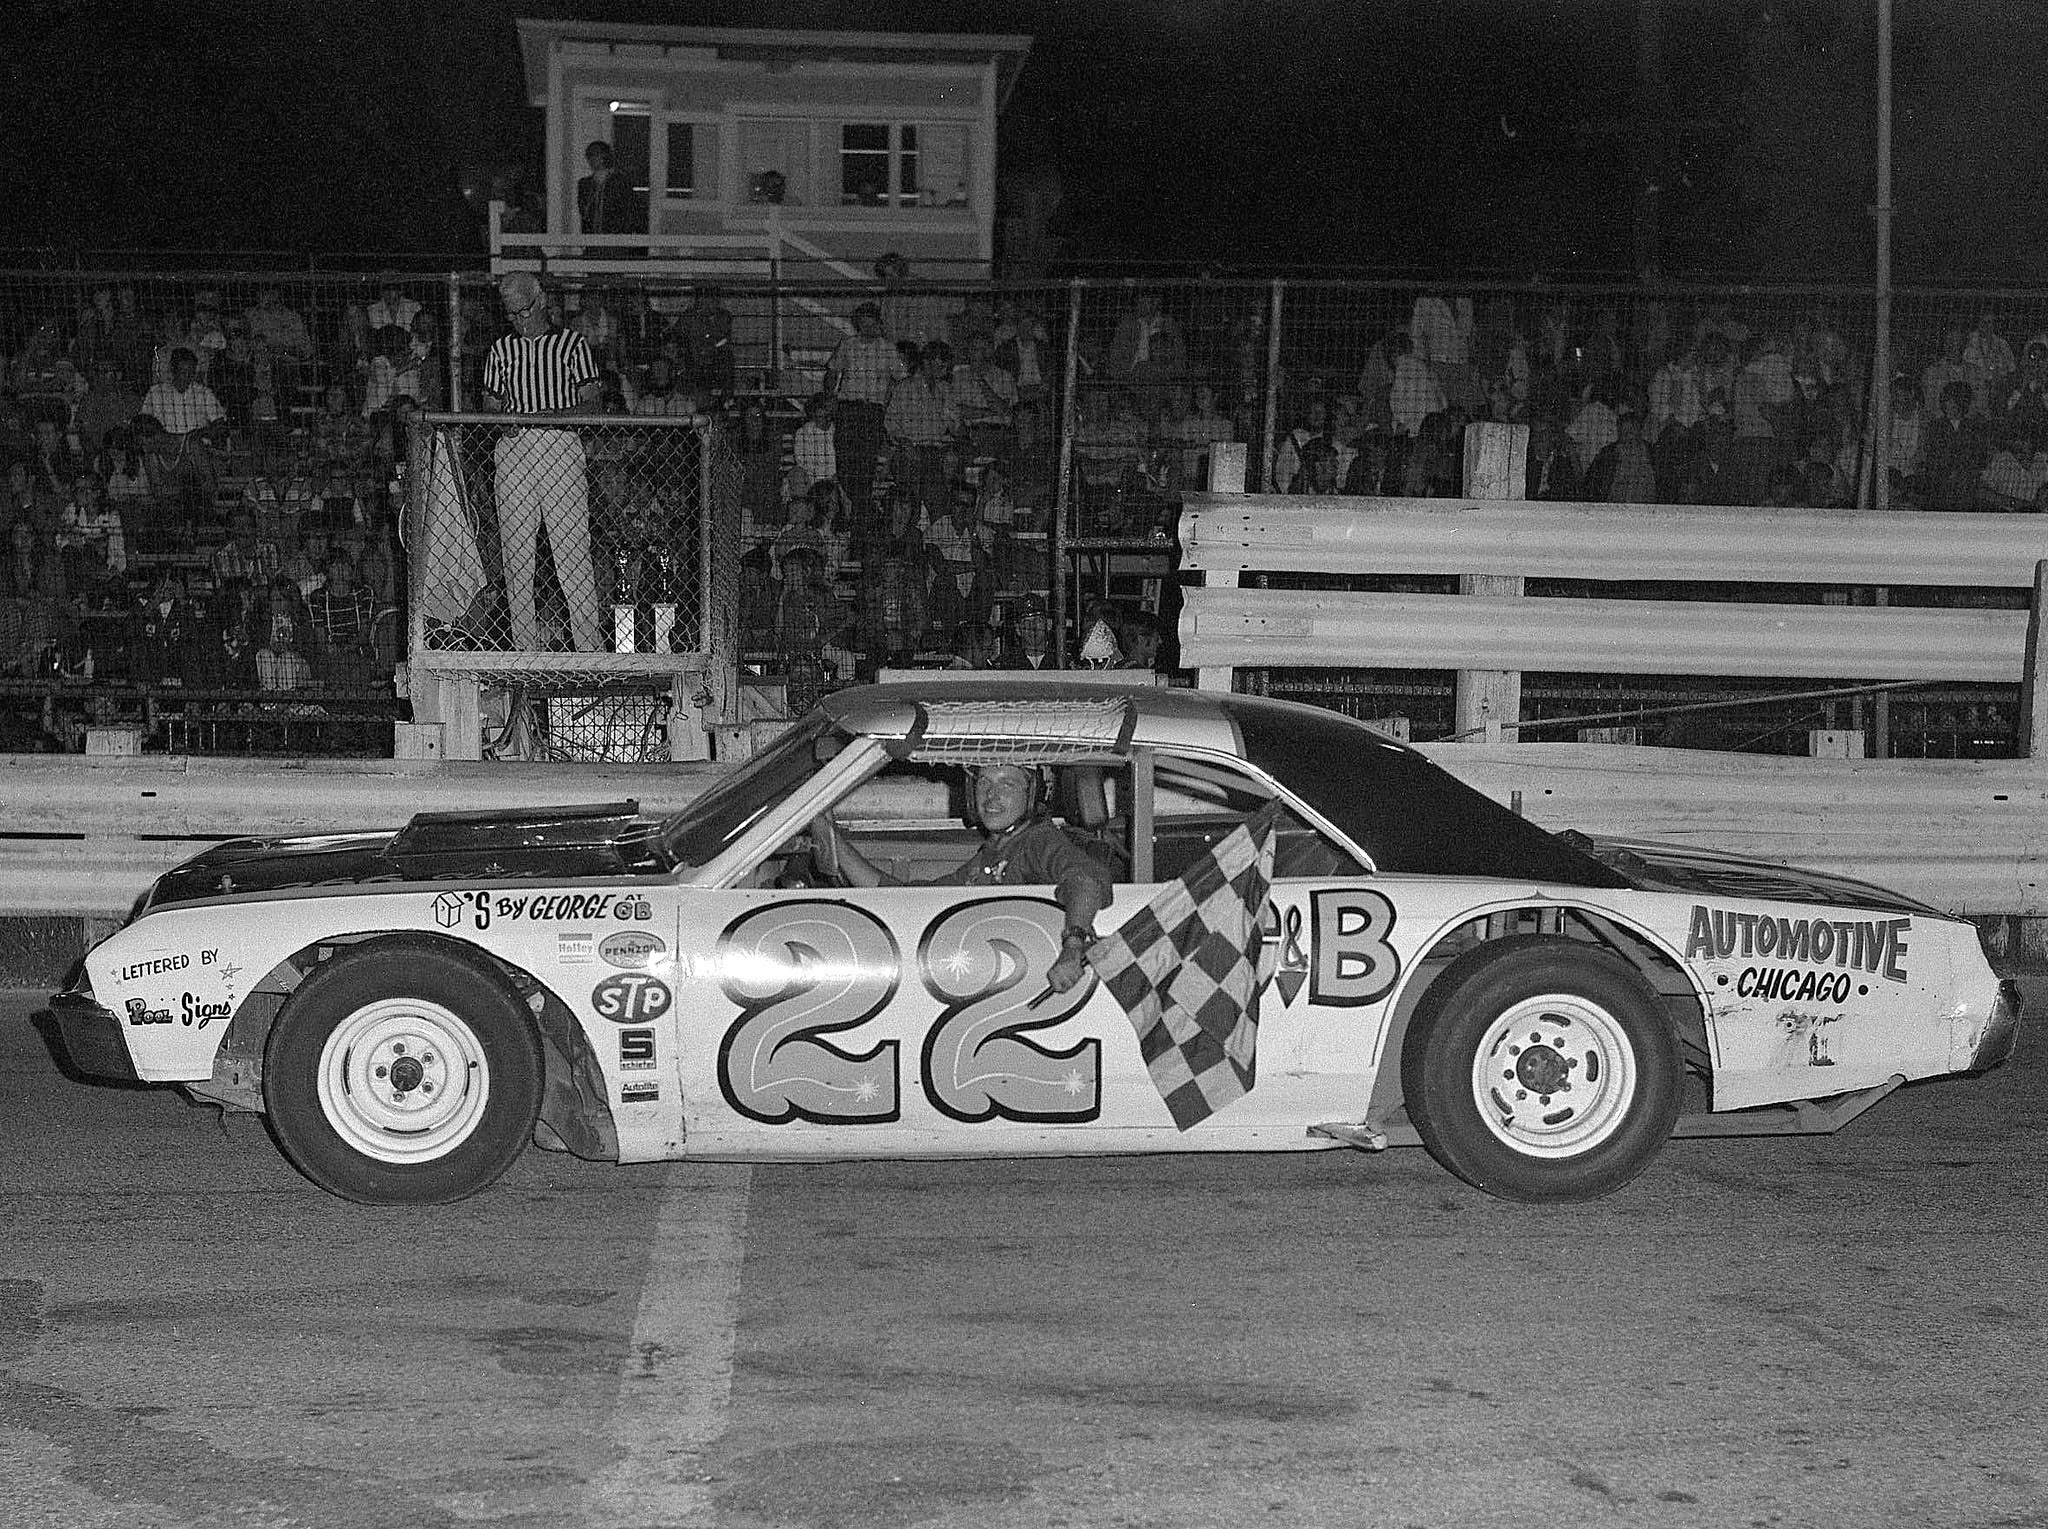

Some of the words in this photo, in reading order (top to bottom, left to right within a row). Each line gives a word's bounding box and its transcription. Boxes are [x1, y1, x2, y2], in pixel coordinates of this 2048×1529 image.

[529, 893, 617, 920] GEORGE
[613, 901, 653, 920] GB
[1684, 904, 1913, 984] AUTOMOTIVE
[122, 954, 190, 981] LETTERED
[201, 948, 219, 966] BY
[599, 977, 666, 1019] STP
[1737, 966, 1851, 1004] CHICAGO
[181, 991, 232, 1031] Signs
[717, 895, 1102, 1125] 22
